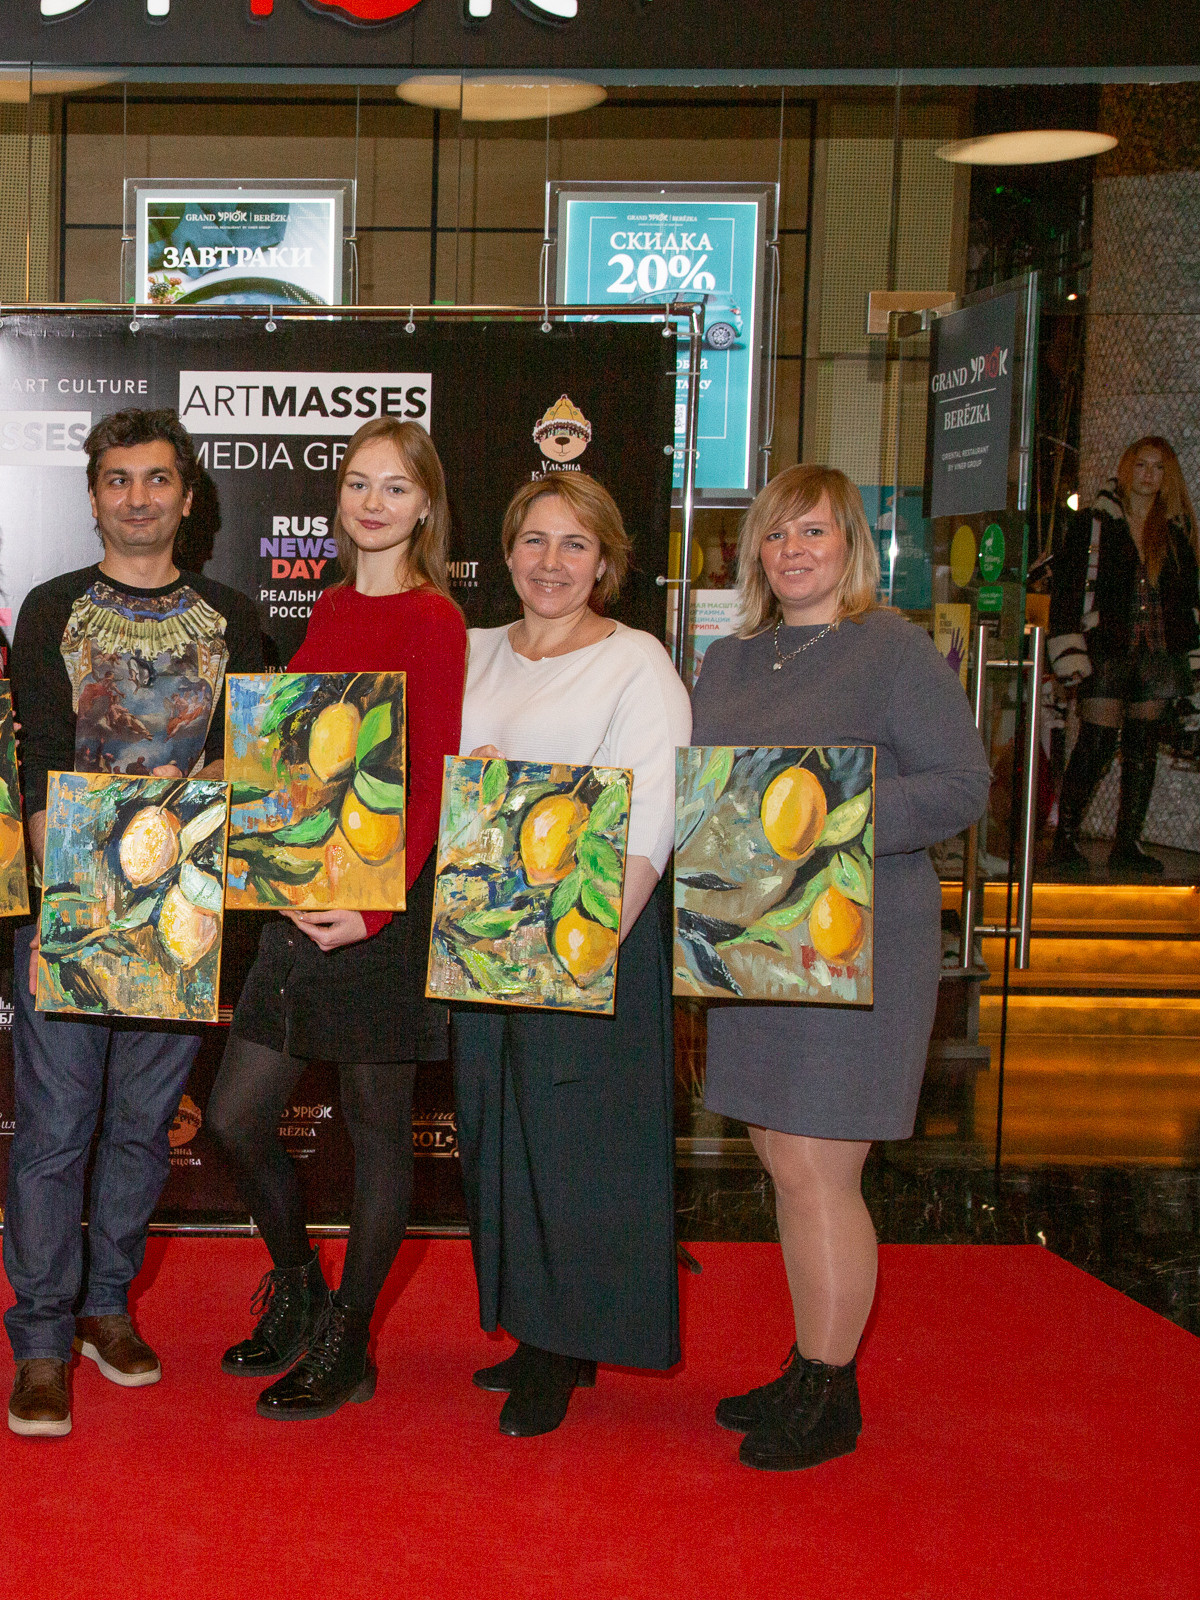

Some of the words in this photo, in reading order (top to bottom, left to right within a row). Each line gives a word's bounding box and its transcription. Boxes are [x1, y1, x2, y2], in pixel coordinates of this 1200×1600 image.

[185, 213, 216, 222] GRAND
[610, 231, 714, 254] СКИДКА
[163, 246, 313, 269] ЗАВТРАКИ
[606, 253, 716, 294] 20%
[11, 378, 49, 392] ART
[57, 379, 148, 394] CULTURE
[931, 367, 969, 393] GRAND
[182, 385, 428, 418] ARTMASSES
[540, 460, 581, 474] Ульяна
[272, 515, 329, 537] RUS
[260, 537, 339, 558] NEWS
[271, 559, 327, 579] DAY
